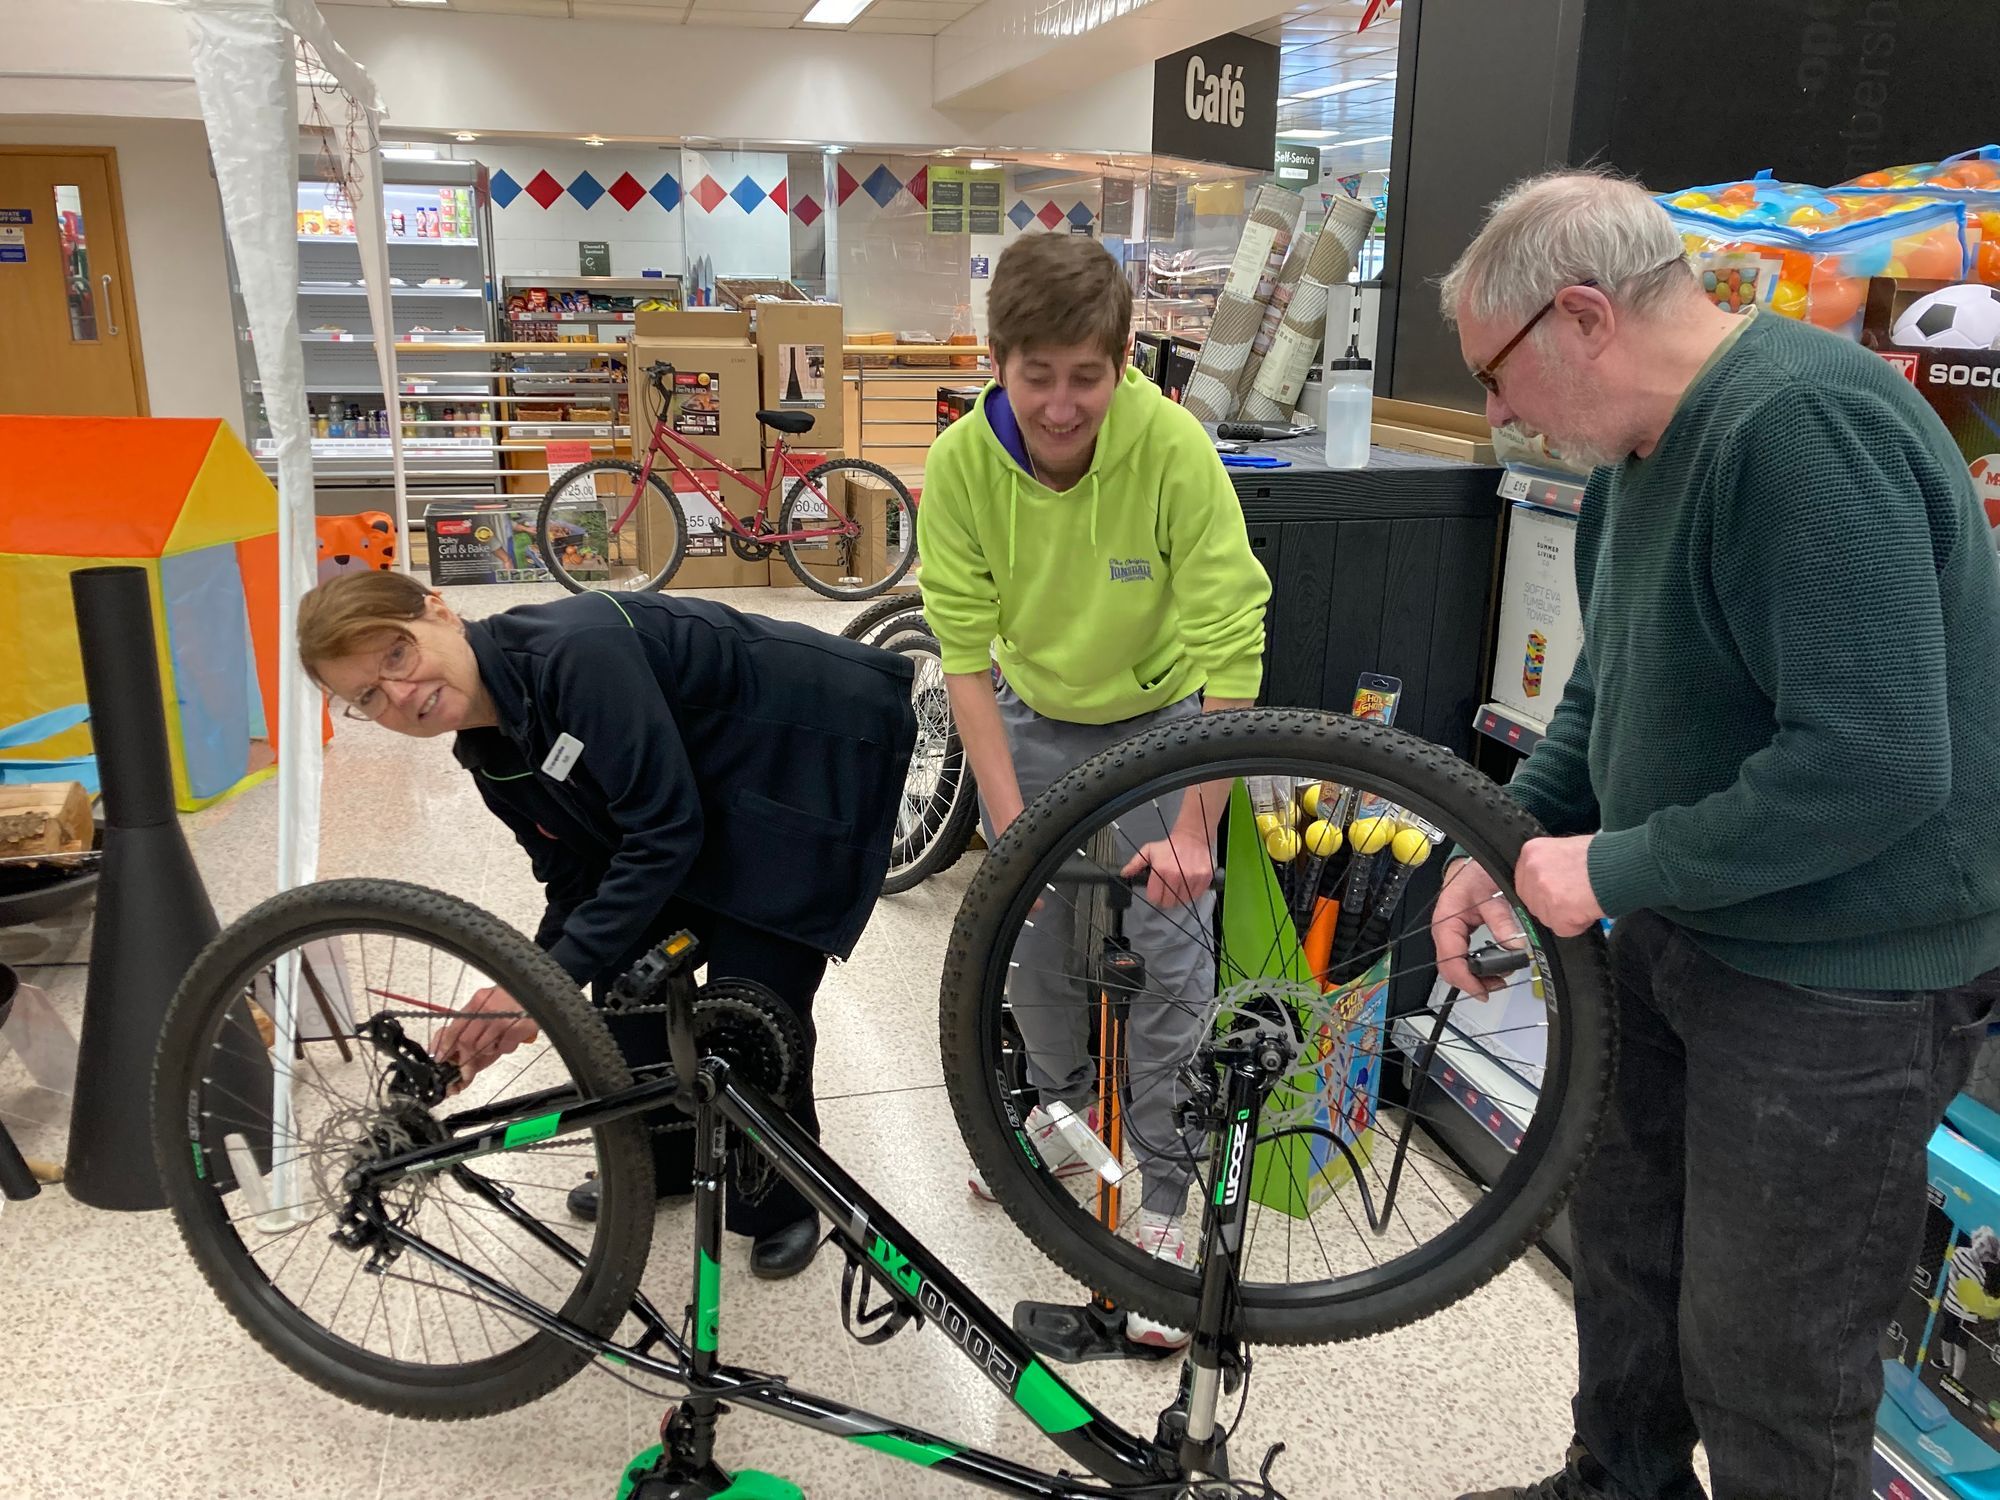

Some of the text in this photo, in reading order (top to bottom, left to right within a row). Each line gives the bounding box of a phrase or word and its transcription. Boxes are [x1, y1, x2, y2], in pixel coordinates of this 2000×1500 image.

[1185, 55, 1245, 128] Café
[1275, 151, 1315, 165] Self-Service
[561, 484, 594, 497] 125.00
[1513, 481, 1527, 493] £15
[793, 500, 826, 512] 60.00
[438, 543, 490, 554] Grill & Bake
[1537, 542, 1559, 553] SUMMER
[1538, 550, 1556, 560] LIVING
[1524, 581, 1561, 602] SOFT EVA
[1523, 593, 1561, 617] TUMBLING
[1526, 607, 1554, 624] TOWER
[867, 1235, 921, 1297] FXT
[919, 1279, 1017, 1393] 2000
